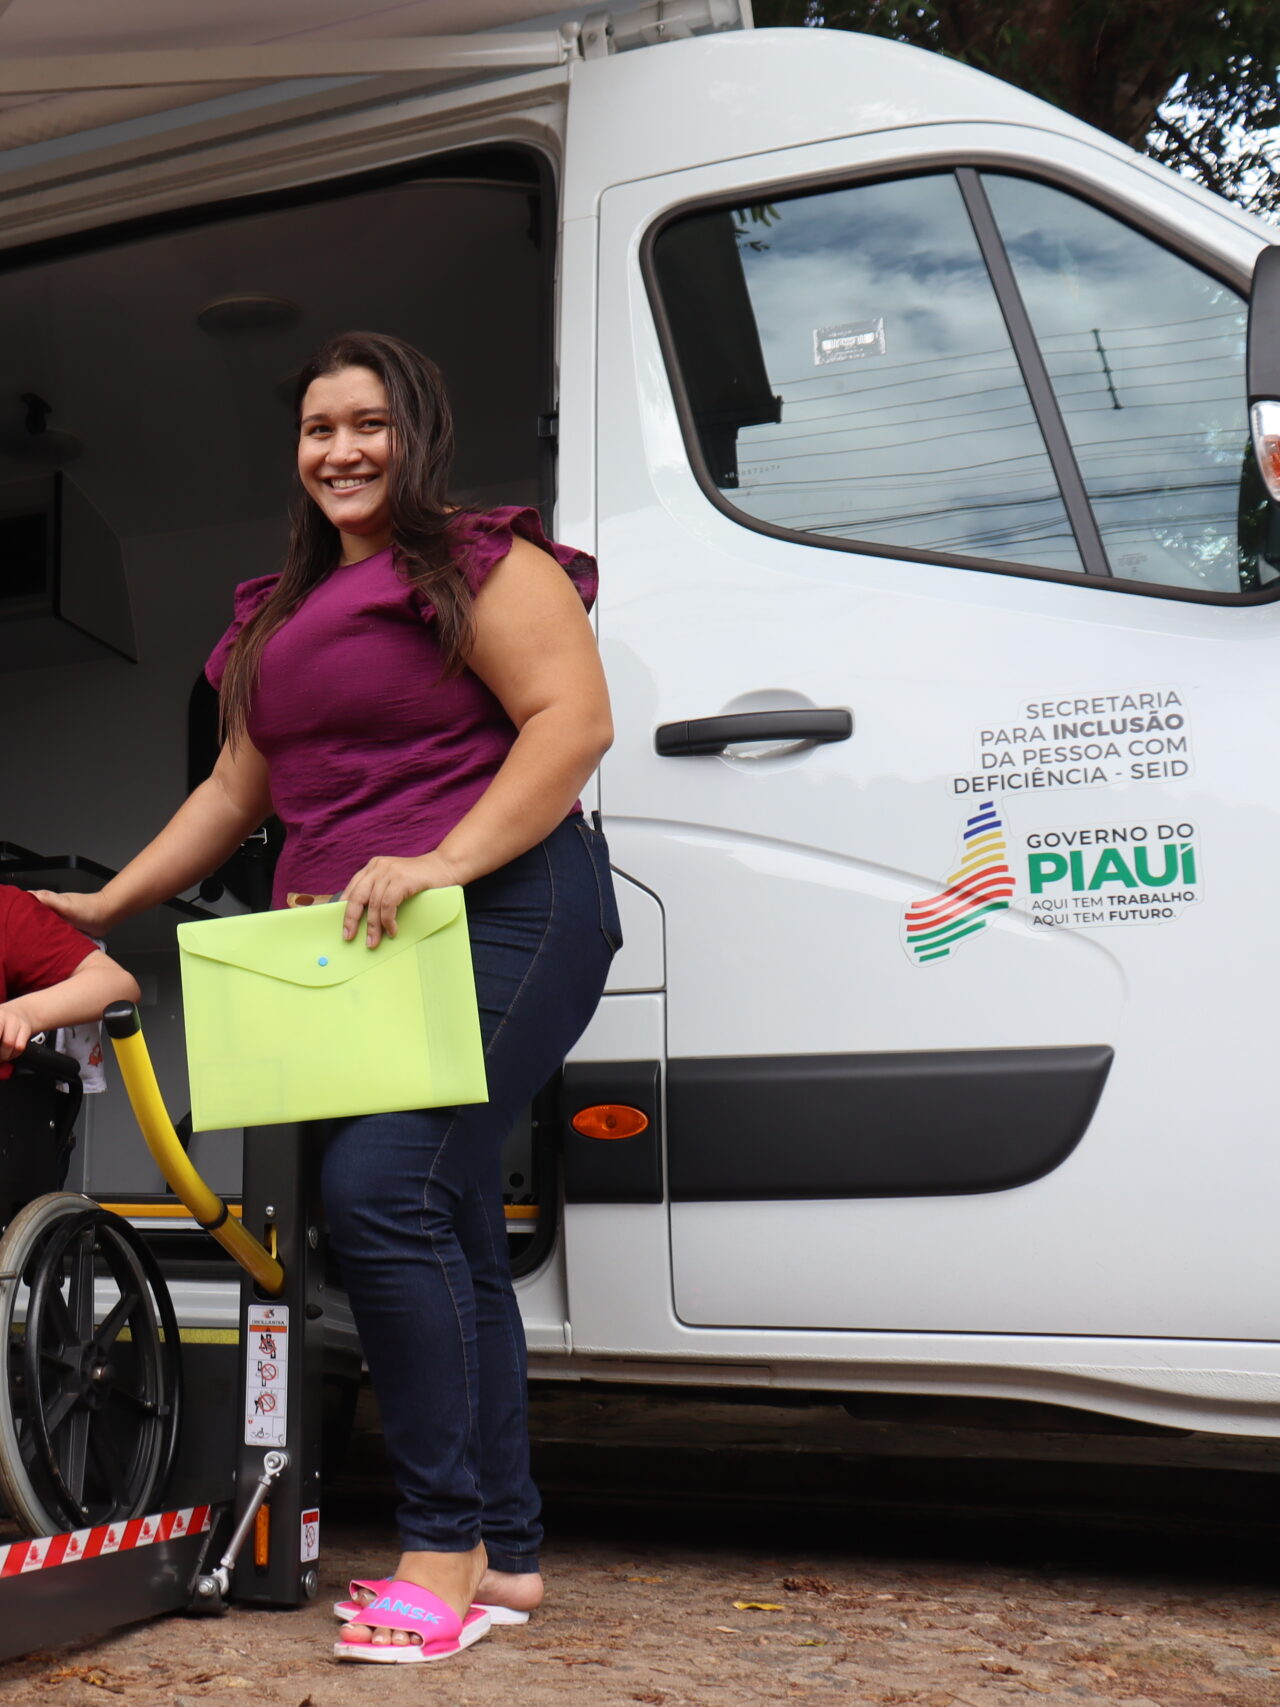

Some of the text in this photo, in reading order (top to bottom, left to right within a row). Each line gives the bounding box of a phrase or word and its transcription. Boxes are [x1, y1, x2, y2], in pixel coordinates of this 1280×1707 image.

[1026, 691, 1182, 719] SECRETARIA
[980, 711, 1184, 747] PARA INCLUSÃO
[981, 736, 1188, 769] DA PESSOA COM
[953, 766, 1107, 794] DEFICIÊNCIA
[1130, 760, 1189, 780] SEID
[1026, 823, 1194, 849] GOVERNO DO
[1028, 843, 1197, 894] PIAUÍ
[1031, 891, 1198, 912] AQUI TEM TRABALHO.
[1033, 907, 1177, 927] AQUI TEM FUTURO.
